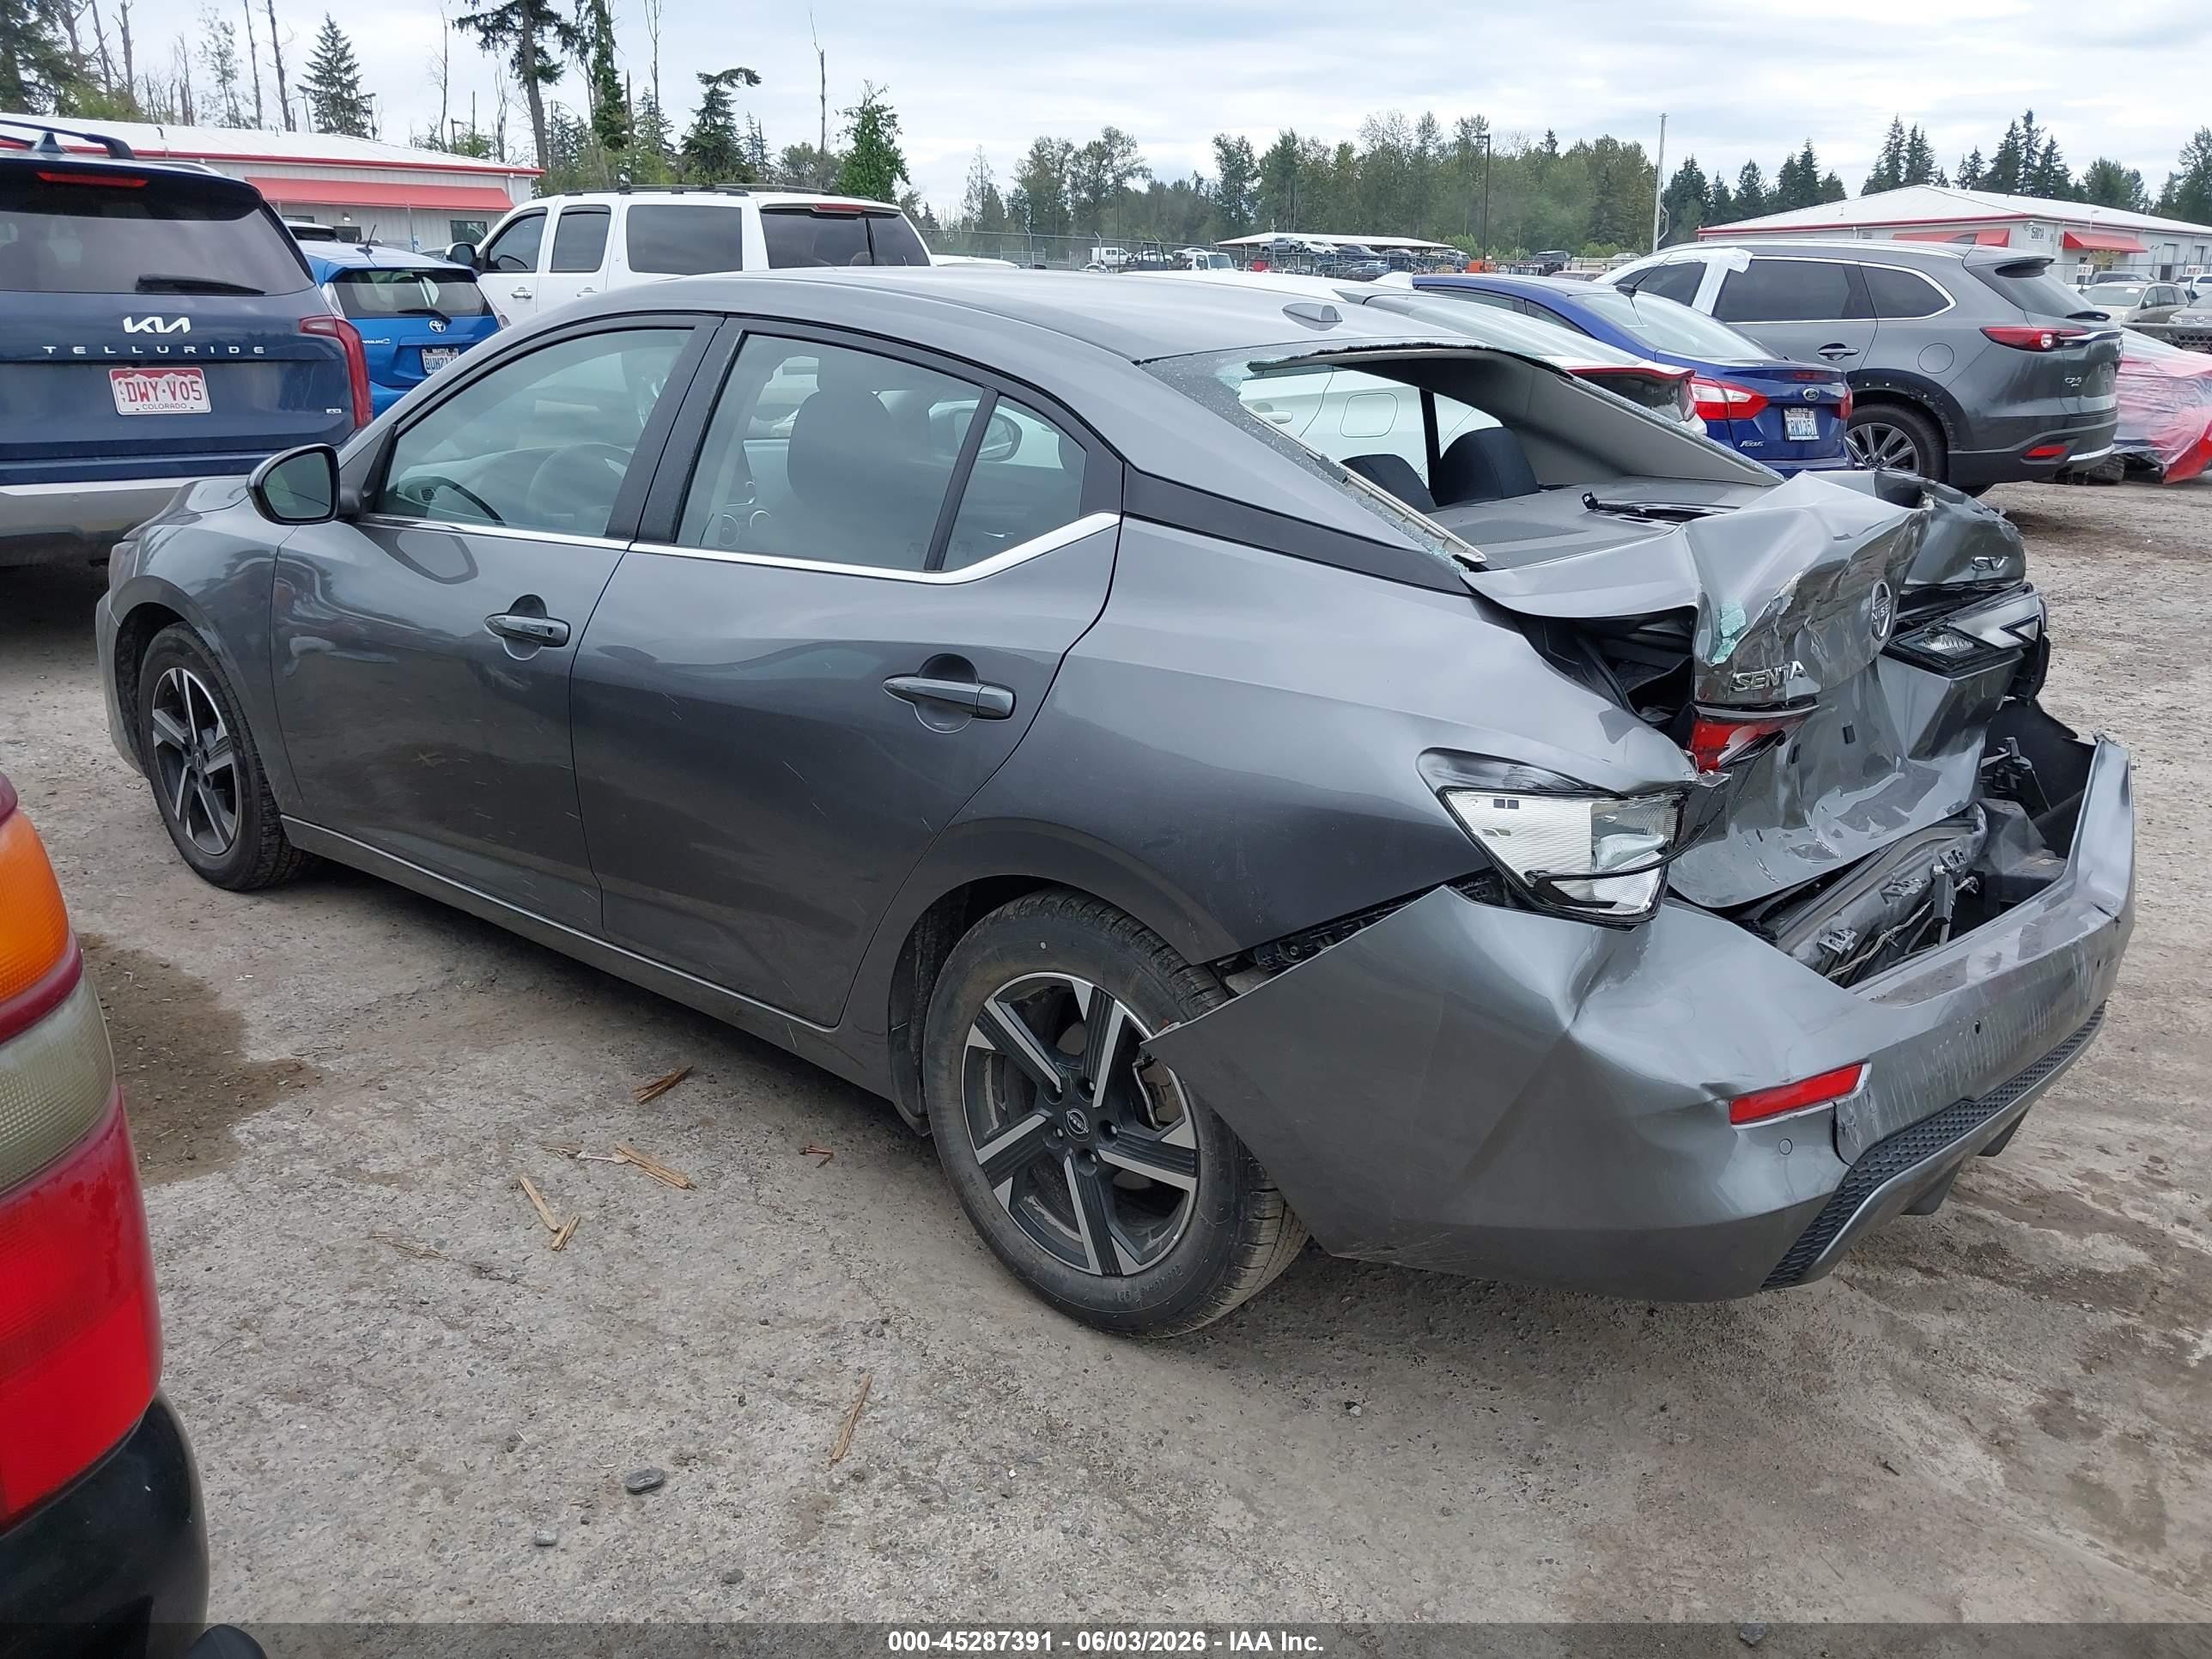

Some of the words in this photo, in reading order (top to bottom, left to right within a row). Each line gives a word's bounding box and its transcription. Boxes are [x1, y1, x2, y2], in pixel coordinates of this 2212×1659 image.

[123, 316, 191, 333] KIA
[424, 357, 456, 370] BUH21
[1972, 556, 2008, 571] SV
[1730, 660, 1808, 692] SENTA
